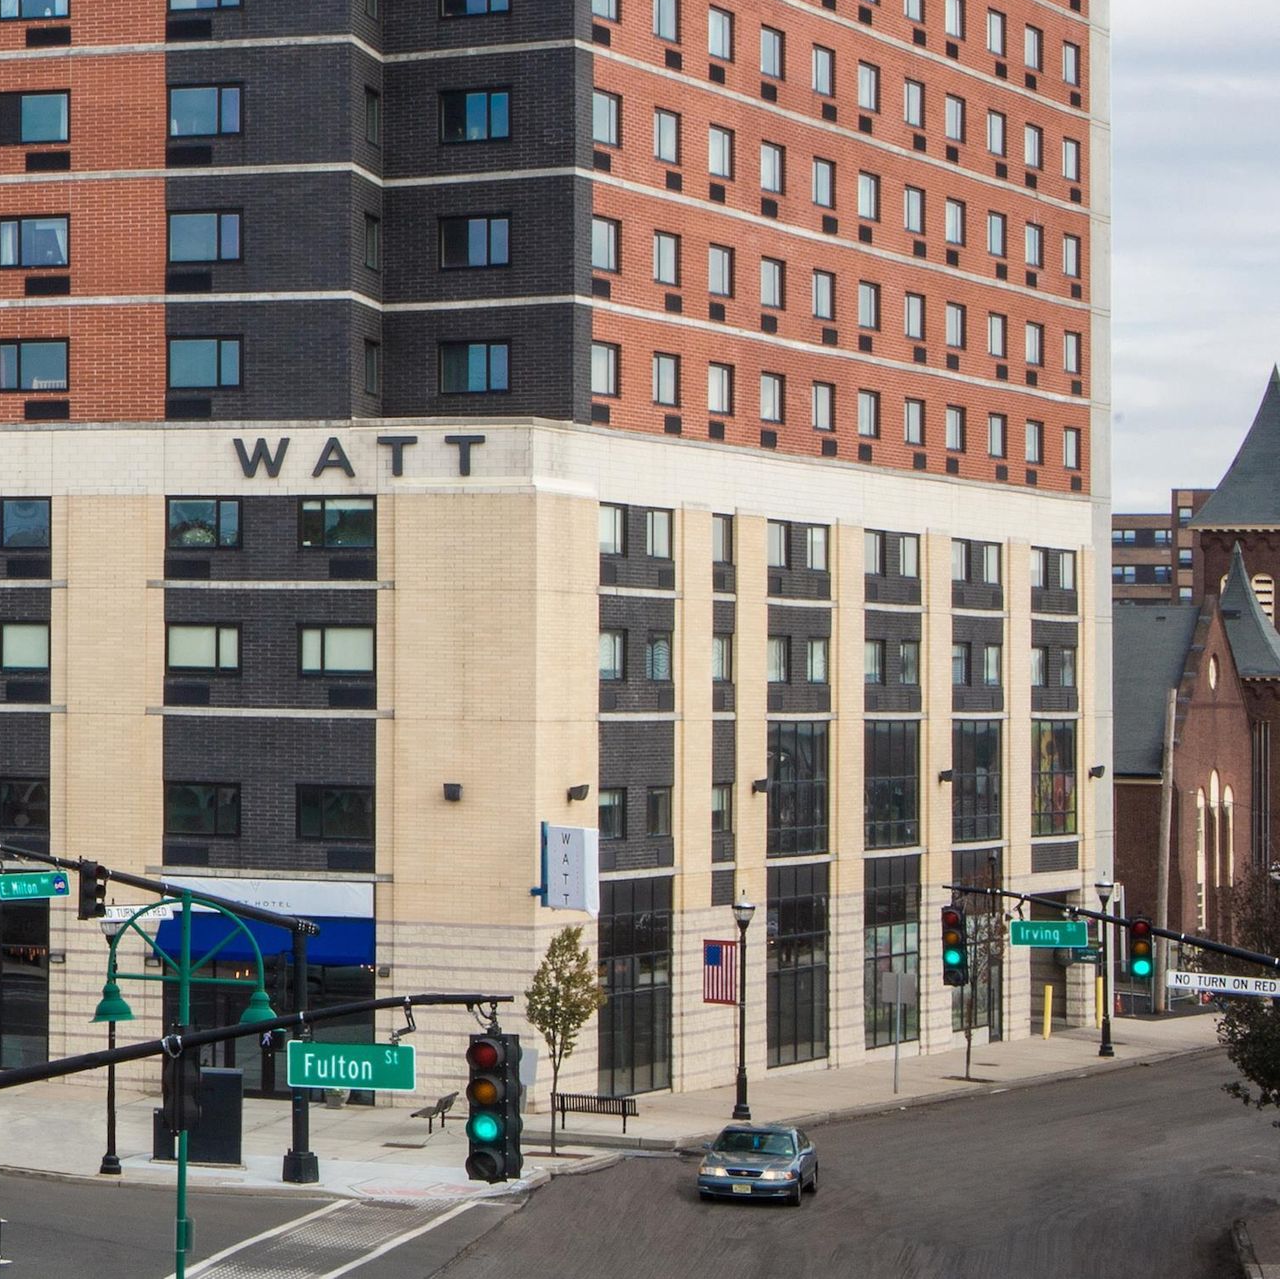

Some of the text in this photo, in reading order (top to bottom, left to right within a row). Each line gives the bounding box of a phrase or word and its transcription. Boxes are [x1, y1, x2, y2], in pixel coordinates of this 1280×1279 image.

[233, 435, 486, 478] WATT
[561, 832, 571, 905] WATT
[11, 880, 39, 896] Milton
[152, 906, 168, 918] RED
[255, 900, 292, 909] HOTEL
[1020, 926, 1060, 944] Irving
[1175, 974, 1277, 993] NO TURN ON RED
[304, 1049, 399, 1080] Fulton St
